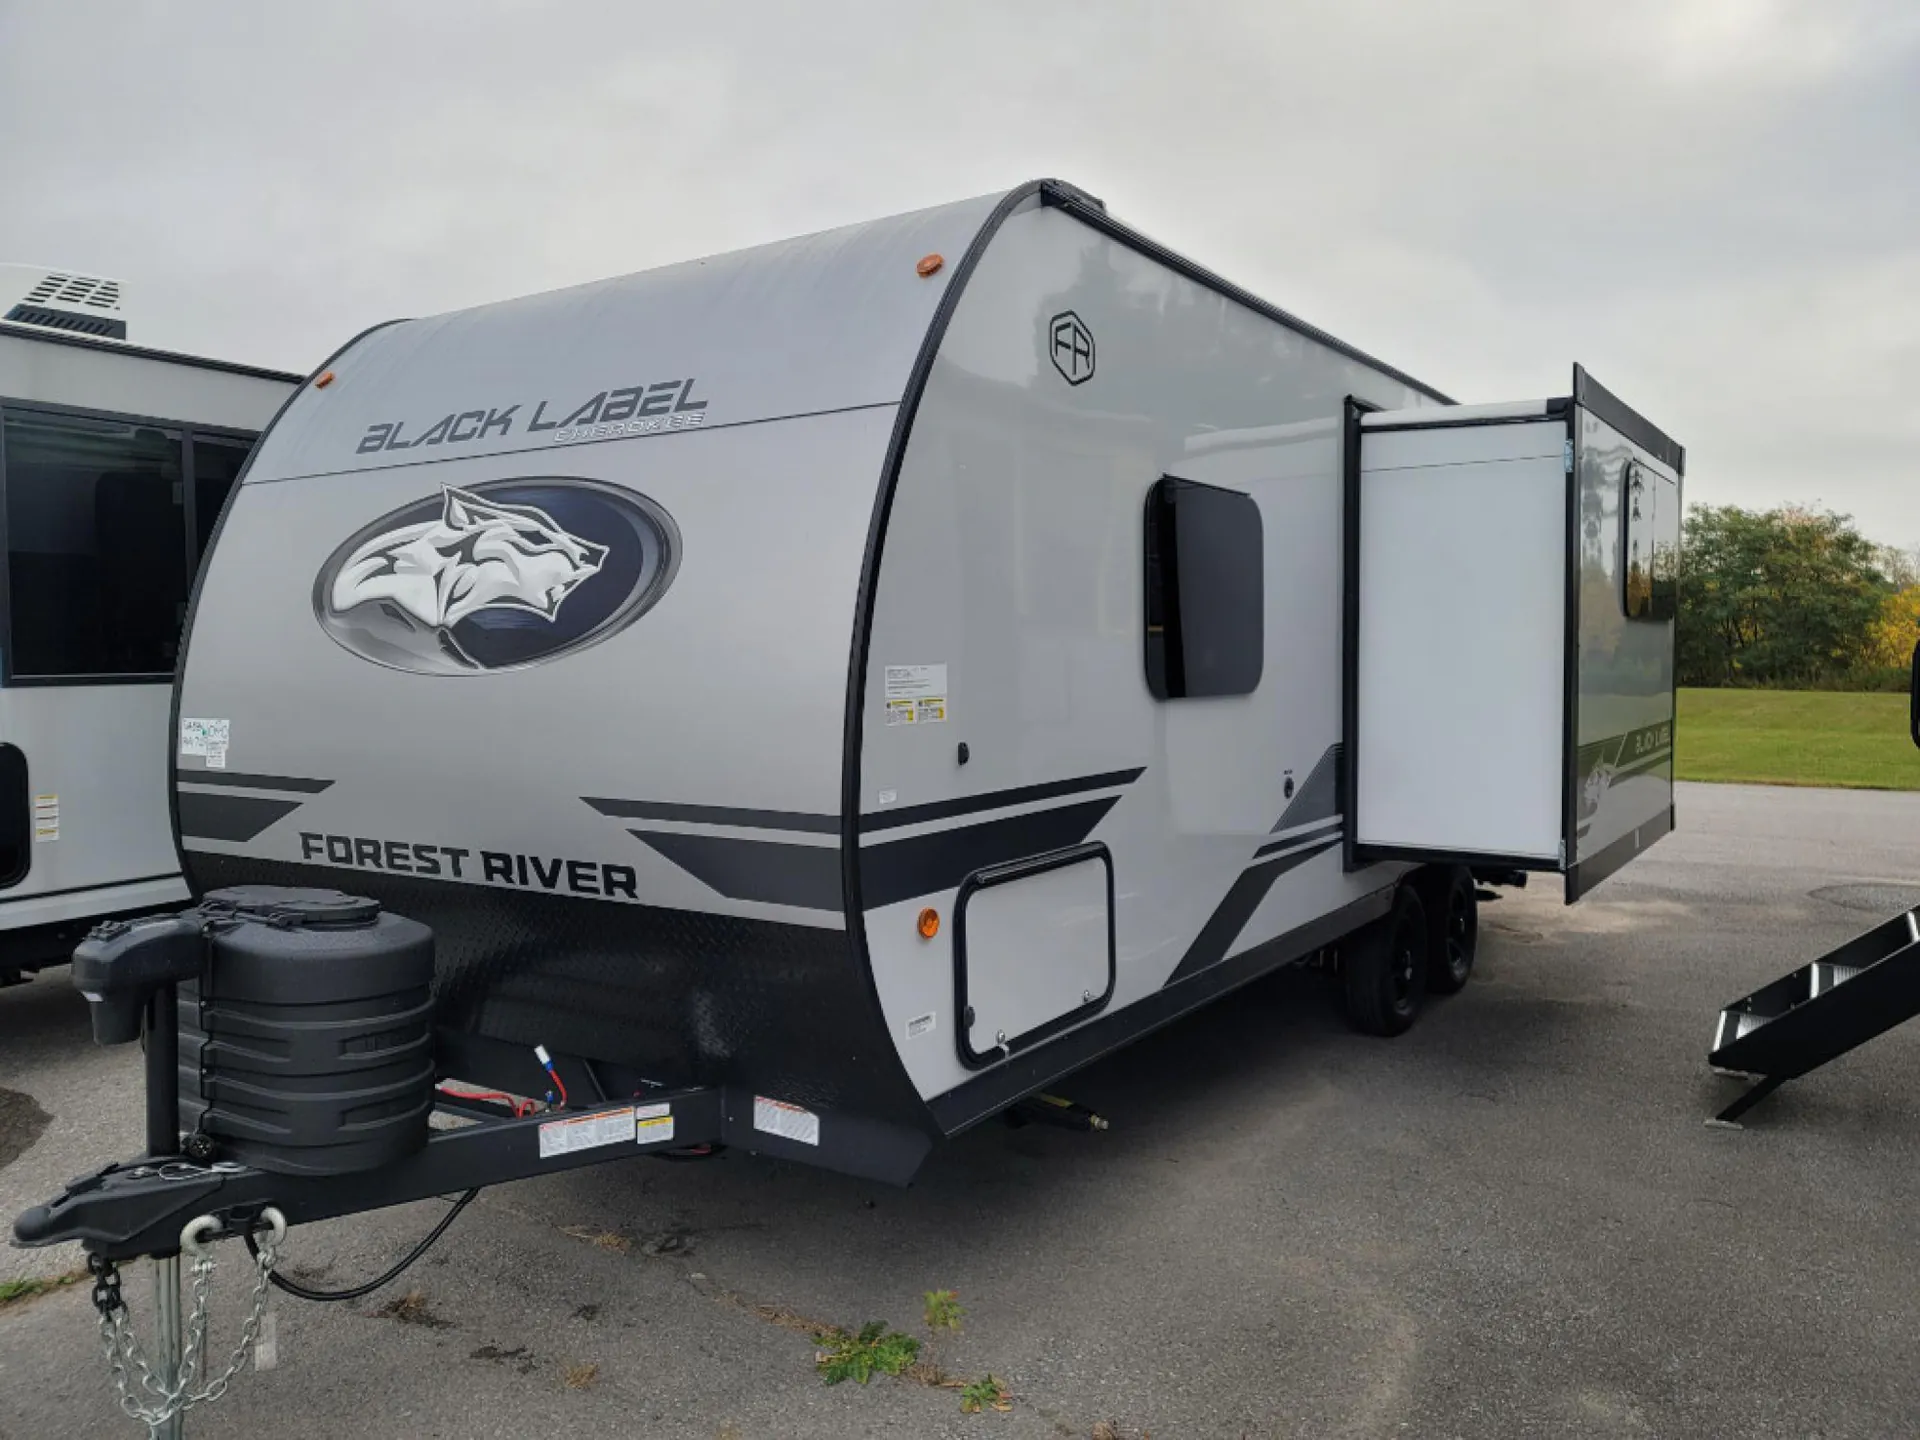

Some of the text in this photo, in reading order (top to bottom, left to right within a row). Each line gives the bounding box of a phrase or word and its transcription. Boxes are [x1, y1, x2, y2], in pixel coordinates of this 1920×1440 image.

[356, 378, 709, 454] BLACK LABEL
[554, 412, 706, 443] CHEROKEE
[299, 831, 639, 899] FOREST RIVER
